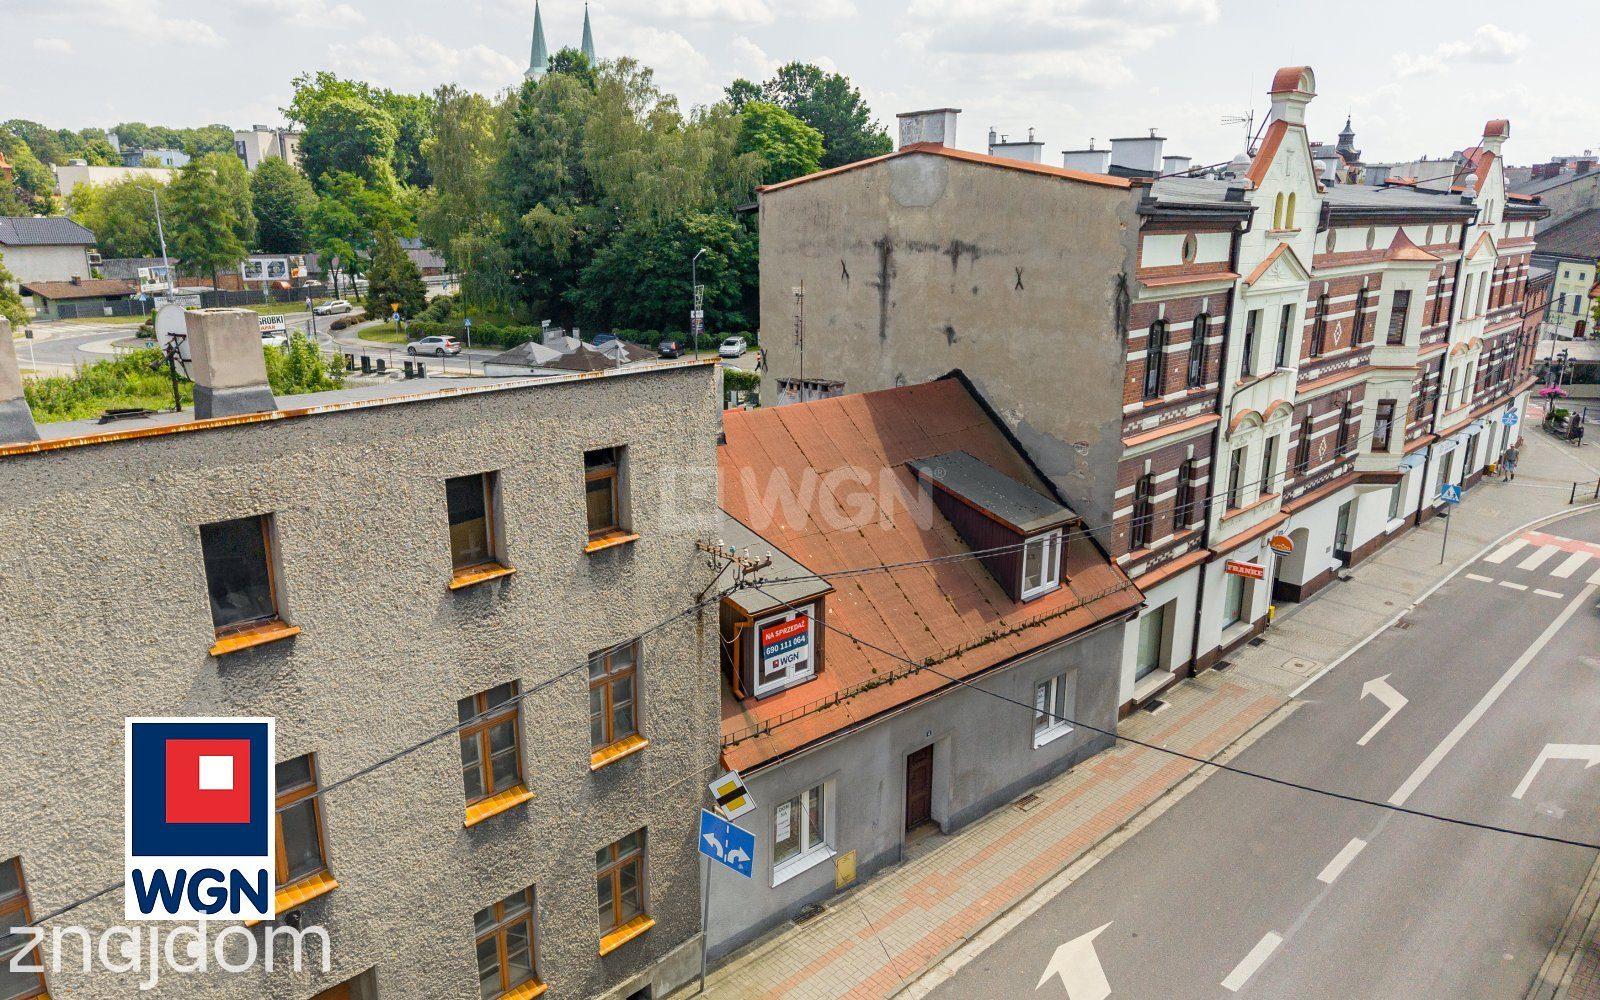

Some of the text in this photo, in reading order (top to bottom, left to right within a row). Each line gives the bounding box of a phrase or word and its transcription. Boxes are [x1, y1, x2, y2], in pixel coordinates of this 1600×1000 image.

[765, 620, 805, 641] NA SPRZEDAŻ
[766, 635, 805, 655] 690 111 064
[780, 652, 799, 665] WGN
